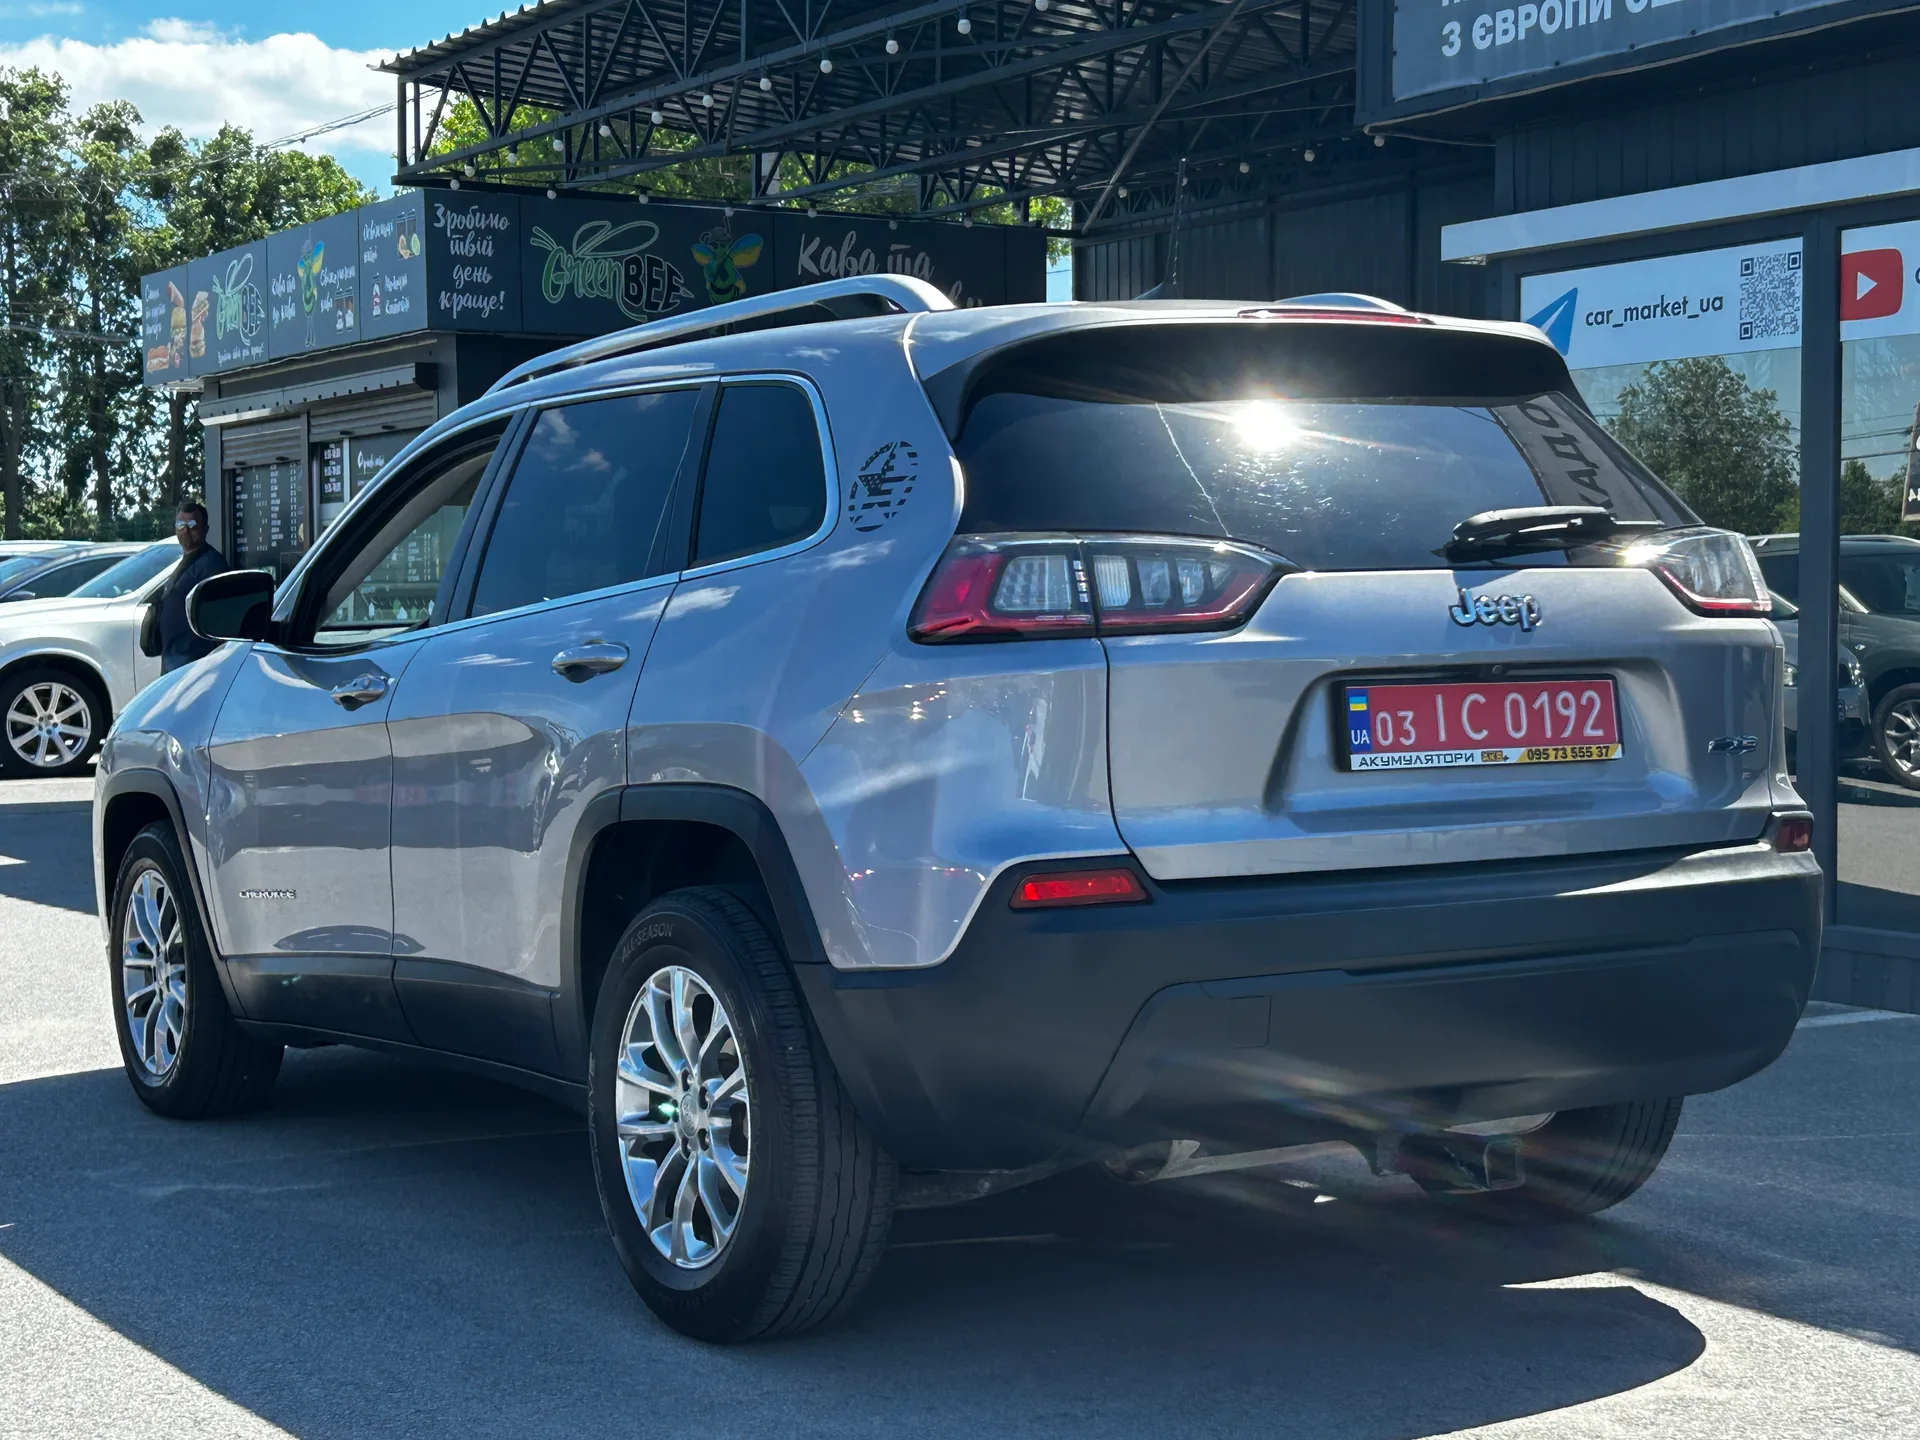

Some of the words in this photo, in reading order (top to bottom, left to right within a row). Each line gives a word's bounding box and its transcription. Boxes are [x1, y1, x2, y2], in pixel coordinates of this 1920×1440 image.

[1441, 21, 1461, 57] З
[1472, 0, 1612, 51] ЄВРОПИ
[433, 203, 510, 237] Зробимо
[449, 231, 495, 258] твій
[798, 230, 879, 281] Кава
[452, 263, 493, 289] день
[541, 245, 692, 323] GreenBEE
[438, 290, 506, 320] краще!
[1585, 294, 1724, 328] car_market_ua
[1449, 588, 1541, 632] Jeep
[1375, 711, 1416, 746] 03
[1504, 690, 1605, 739] 0192
[1351, 729, 1370, 745] UA
[1527, 748, 1550, 761] 095
[1554, 747, 1567, 760] 73
[1571, 746, 1593, 759] 555
[1596, 746, 1611, 758] 37
[1358, 753, 1475, 767] АКУМУЛЯТОРИ
